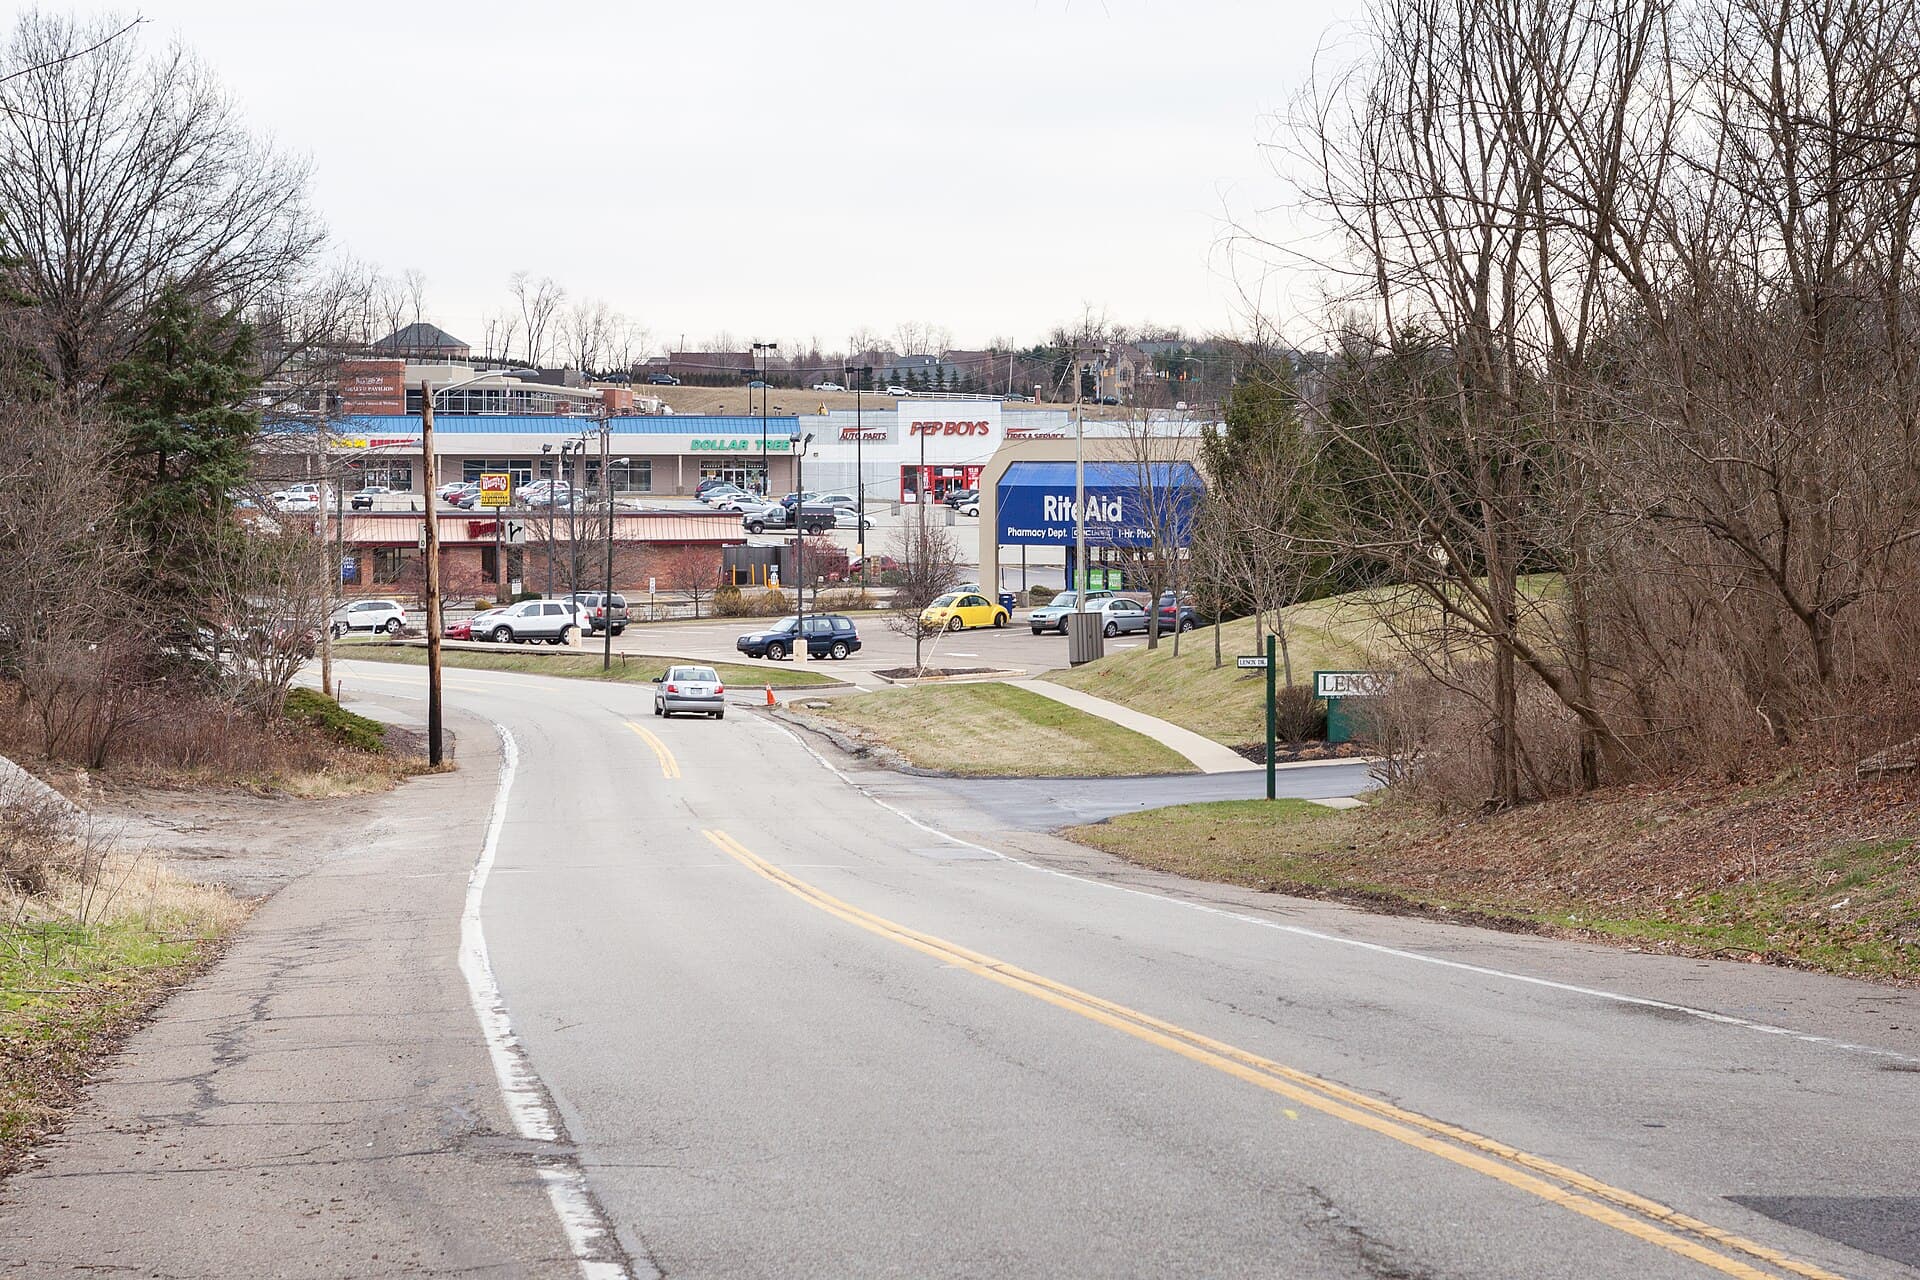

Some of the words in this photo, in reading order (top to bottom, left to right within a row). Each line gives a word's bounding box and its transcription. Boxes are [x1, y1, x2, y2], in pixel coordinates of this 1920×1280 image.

[910, 421, 943, 436] PEP
[944, 421, 990, 436] BOYS
[839, 432, 860, 440] AUTO
[862, 432, 887, 440] PARTS
[691, 439, 749, 451] DOLLAR
[755, 439, 790, 451] TREE
[1007, 527, 1046, 539] Pharmacy
[1047, 527, 1068, 539] Dept.
[1136, 528, 1157, 538] Pho
